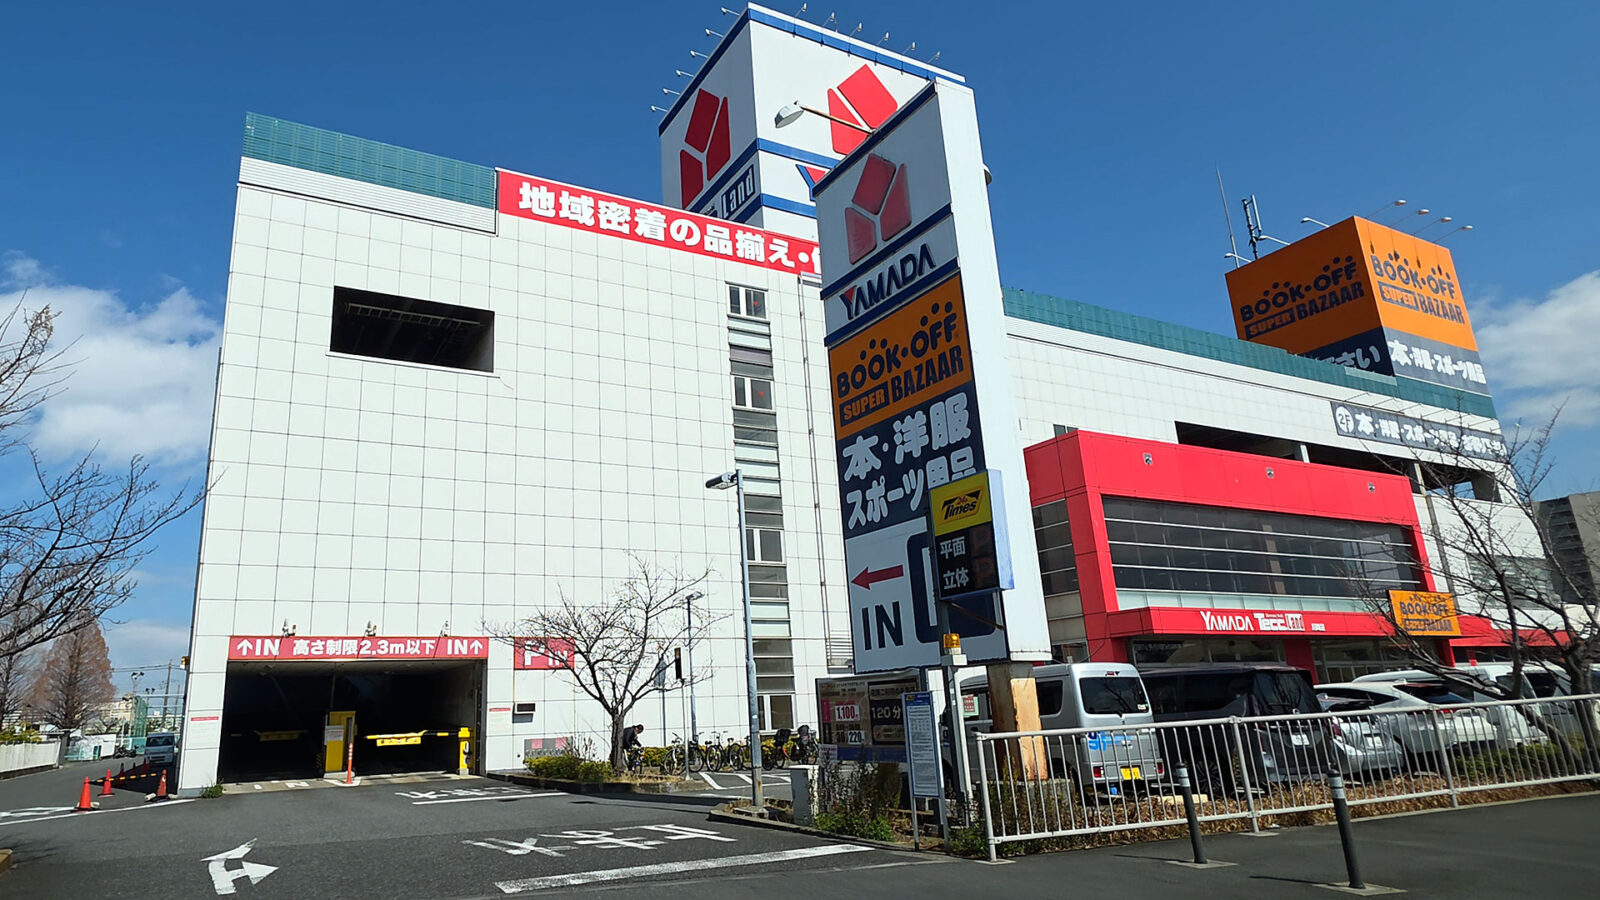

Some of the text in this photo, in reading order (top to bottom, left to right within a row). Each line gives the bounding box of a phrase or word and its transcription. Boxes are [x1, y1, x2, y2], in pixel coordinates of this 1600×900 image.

[722, 167, 755, 218] Land
[838, 243, 936, 321] YAMADA
[1249, 281, 1365, 337] SUPER BAZAAR
[1417, 293, 1466, 325] BAZAAR
[843, 345, 964, 421] SUPER BAZAAR
[843, 392, 971, 482] 本・洋服
[942, 497, 978, 520] Times
[939, 536, 966, 560] 平面
[943, 567, 970, 591] 立体
[861, 600, 904, 651] IN
[1200, 610, 1255, 632] YAMADA
[1253, 613, 1287, 631] Tecc
[255, 638, 468, 656] IN 高さ制限2.3m以下 IN
